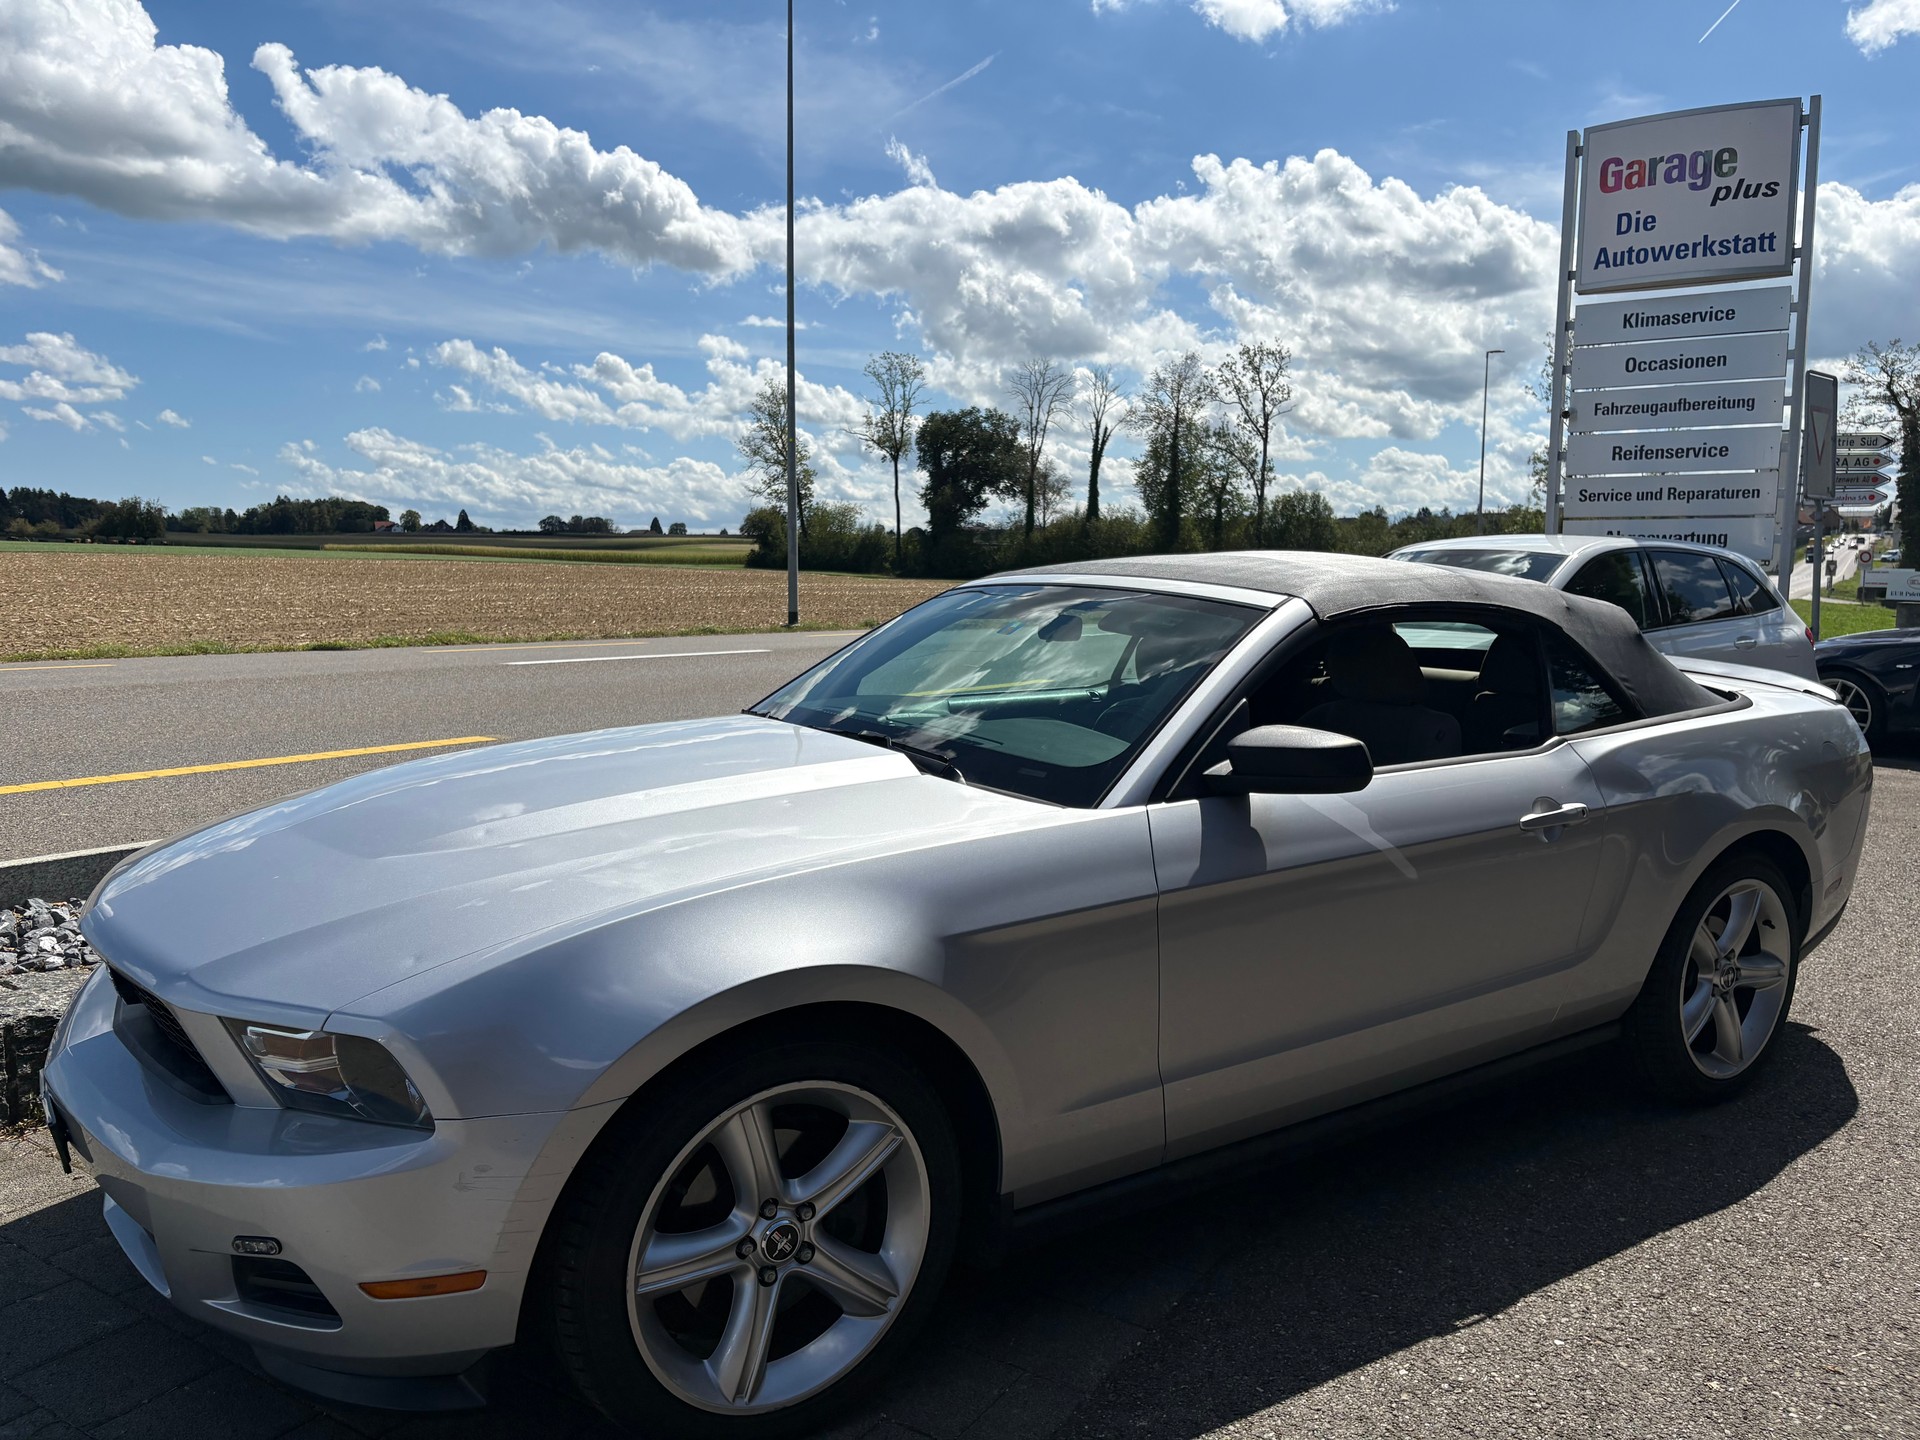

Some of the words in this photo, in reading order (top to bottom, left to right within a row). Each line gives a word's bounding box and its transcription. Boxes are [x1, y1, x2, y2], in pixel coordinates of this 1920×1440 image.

[1599, 146, 1738, 194] Garage
[1710, 178, 1780, 207] plus
[1616, 210, 1657, 236] Die
[1593, 231, 1777, 270] Autowerkstatt
[1622, 306, 1736, 330] Klimaservice
[1624, 353, 1728, 373] Occasionen
[1593, 395, 1756, 417] Fahrzeugaufbereitung
[1860, 435, 1878, 447] Süd
[1611, 443, 1729, 462] Reifenservice
[1854, 457, 1870, 467] AG
[1578, 488, 1632, 503] Service
[1635, 488, 1664, 502] und
[1667, 486, 1761, 503] Reparaturen
